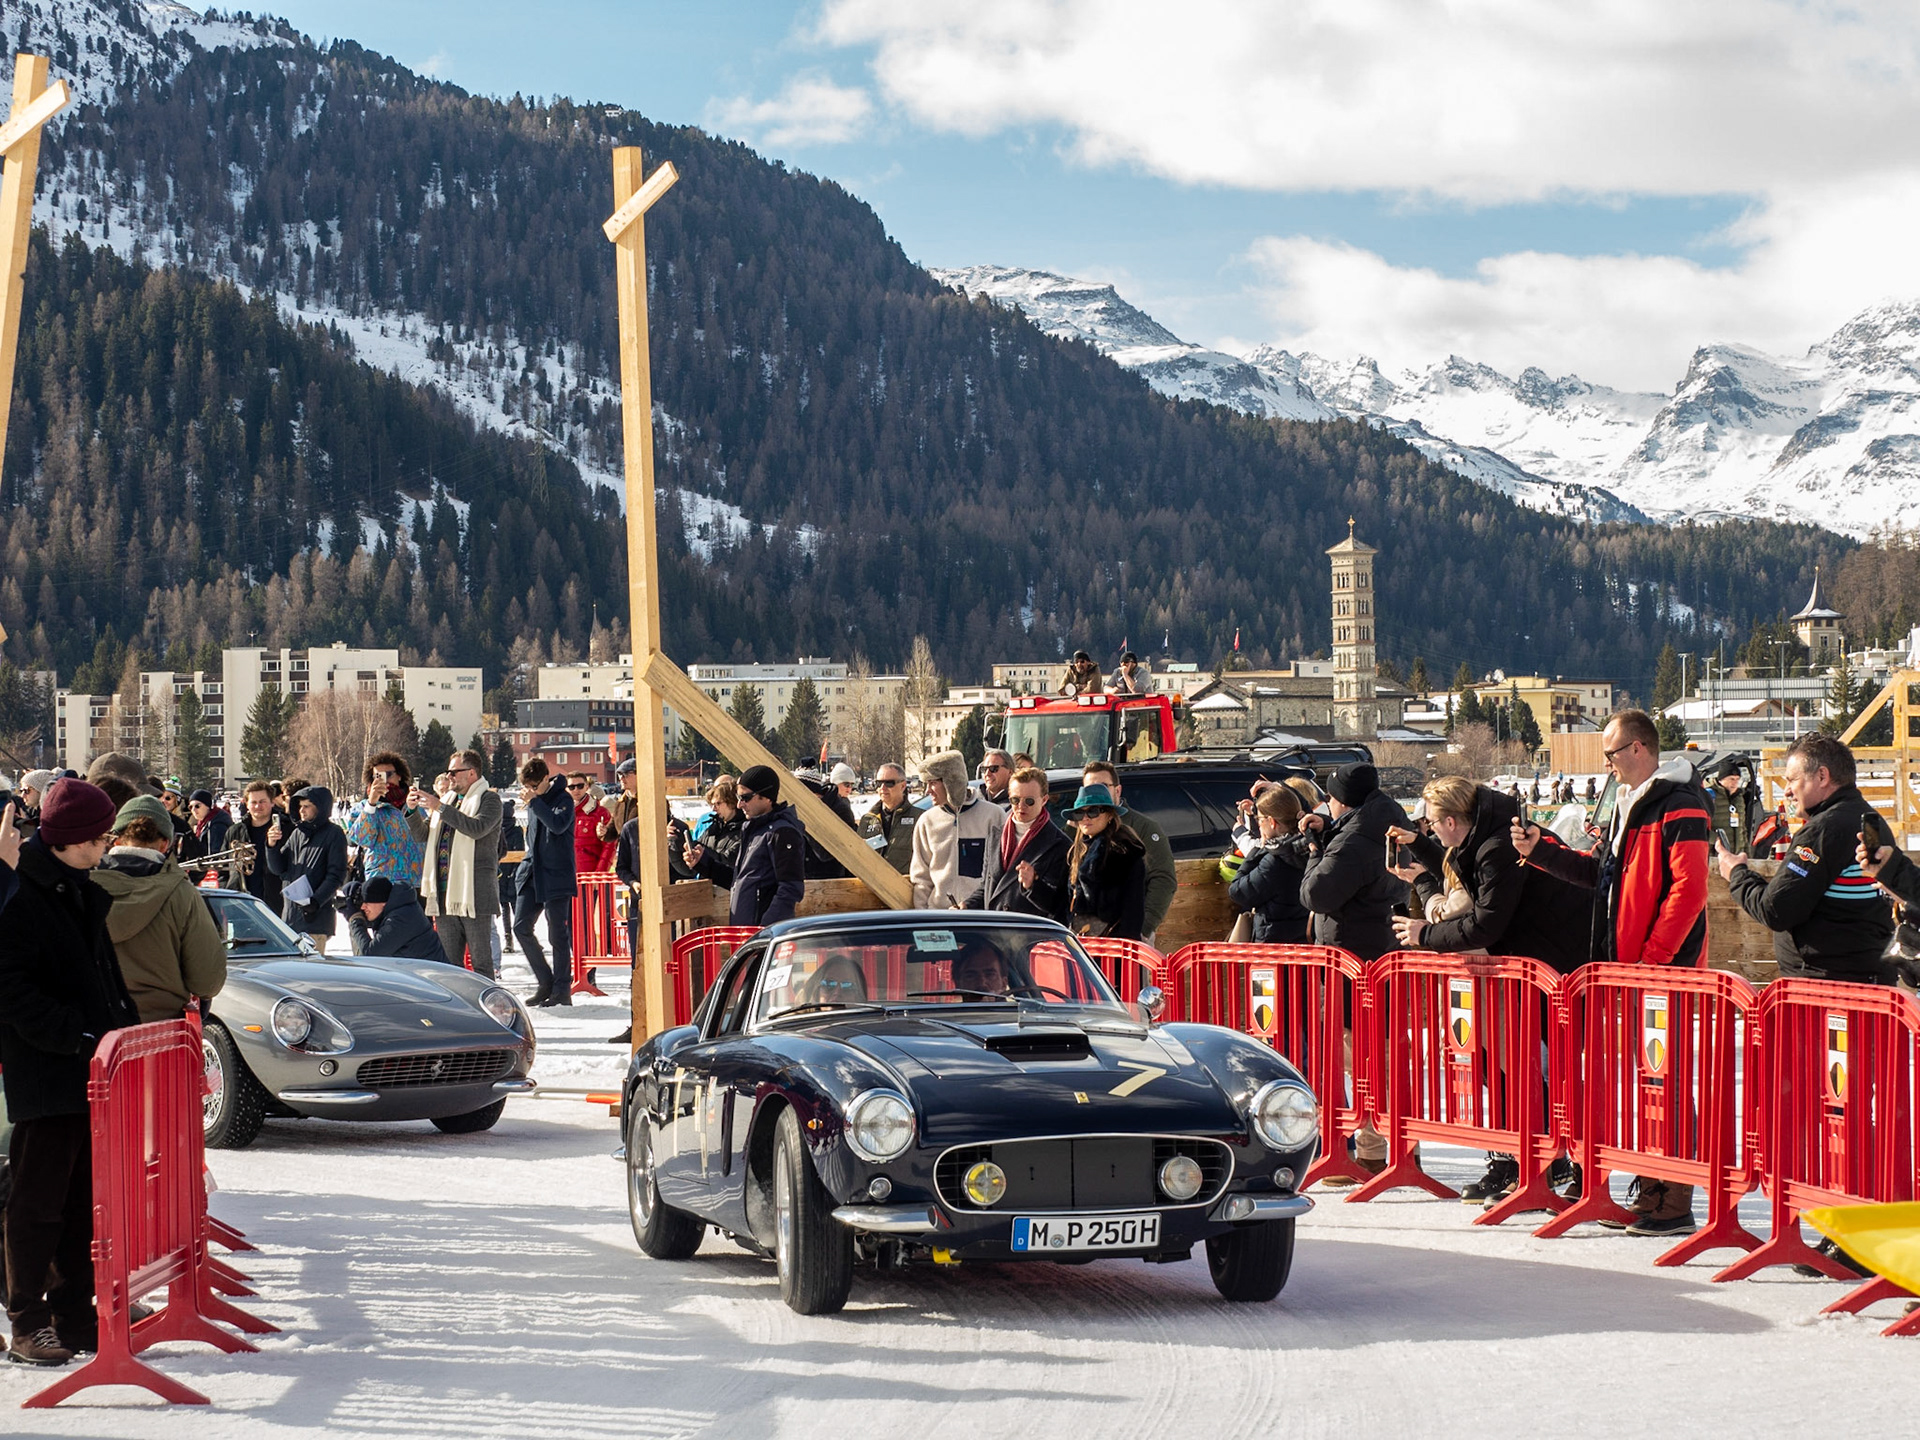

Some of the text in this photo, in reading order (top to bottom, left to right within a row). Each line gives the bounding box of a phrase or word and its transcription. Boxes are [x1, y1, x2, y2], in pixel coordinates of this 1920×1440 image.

[1108, 1060, 1167, 1097] 7
[1017, 1237, 1025, 1246] D
[1030, 1222, 1049, 1247] M
